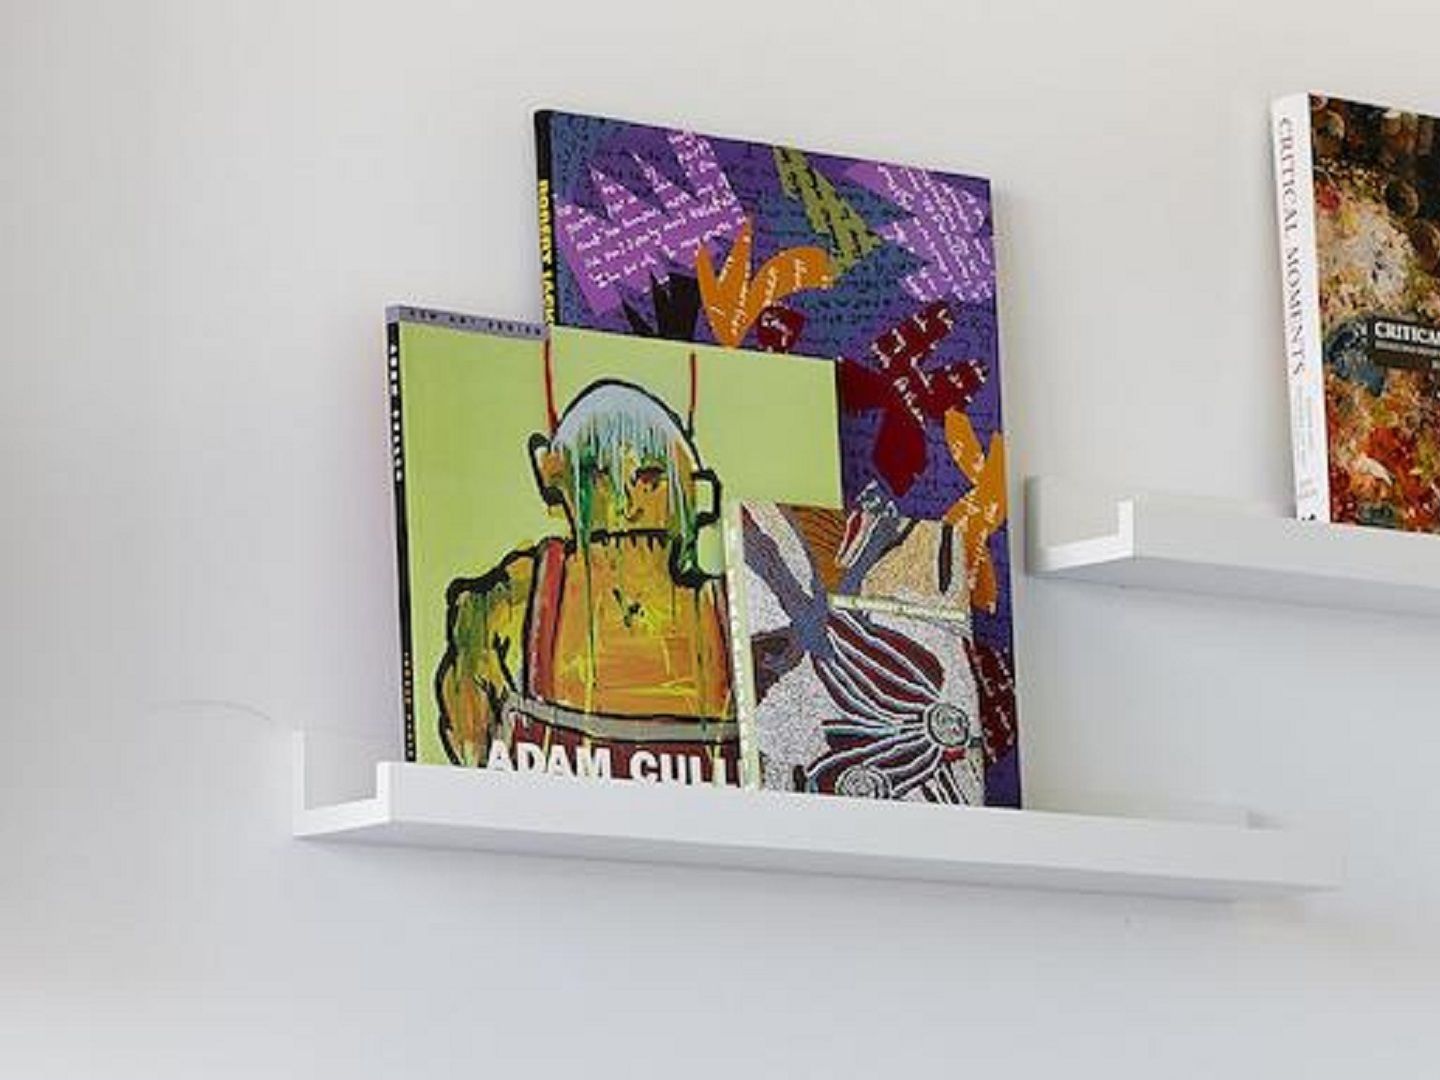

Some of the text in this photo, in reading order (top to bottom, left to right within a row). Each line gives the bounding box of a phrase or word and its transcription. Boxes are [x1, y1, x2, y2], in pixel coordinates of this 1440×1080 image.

[1279, 117, 1298, 232] CRITICAL
[537, 179, 556, 326] ROBERT JACK
[1285, 246, 1306, 376] MOMENTS
[486, 738, 746, 788] ADAM CULL
